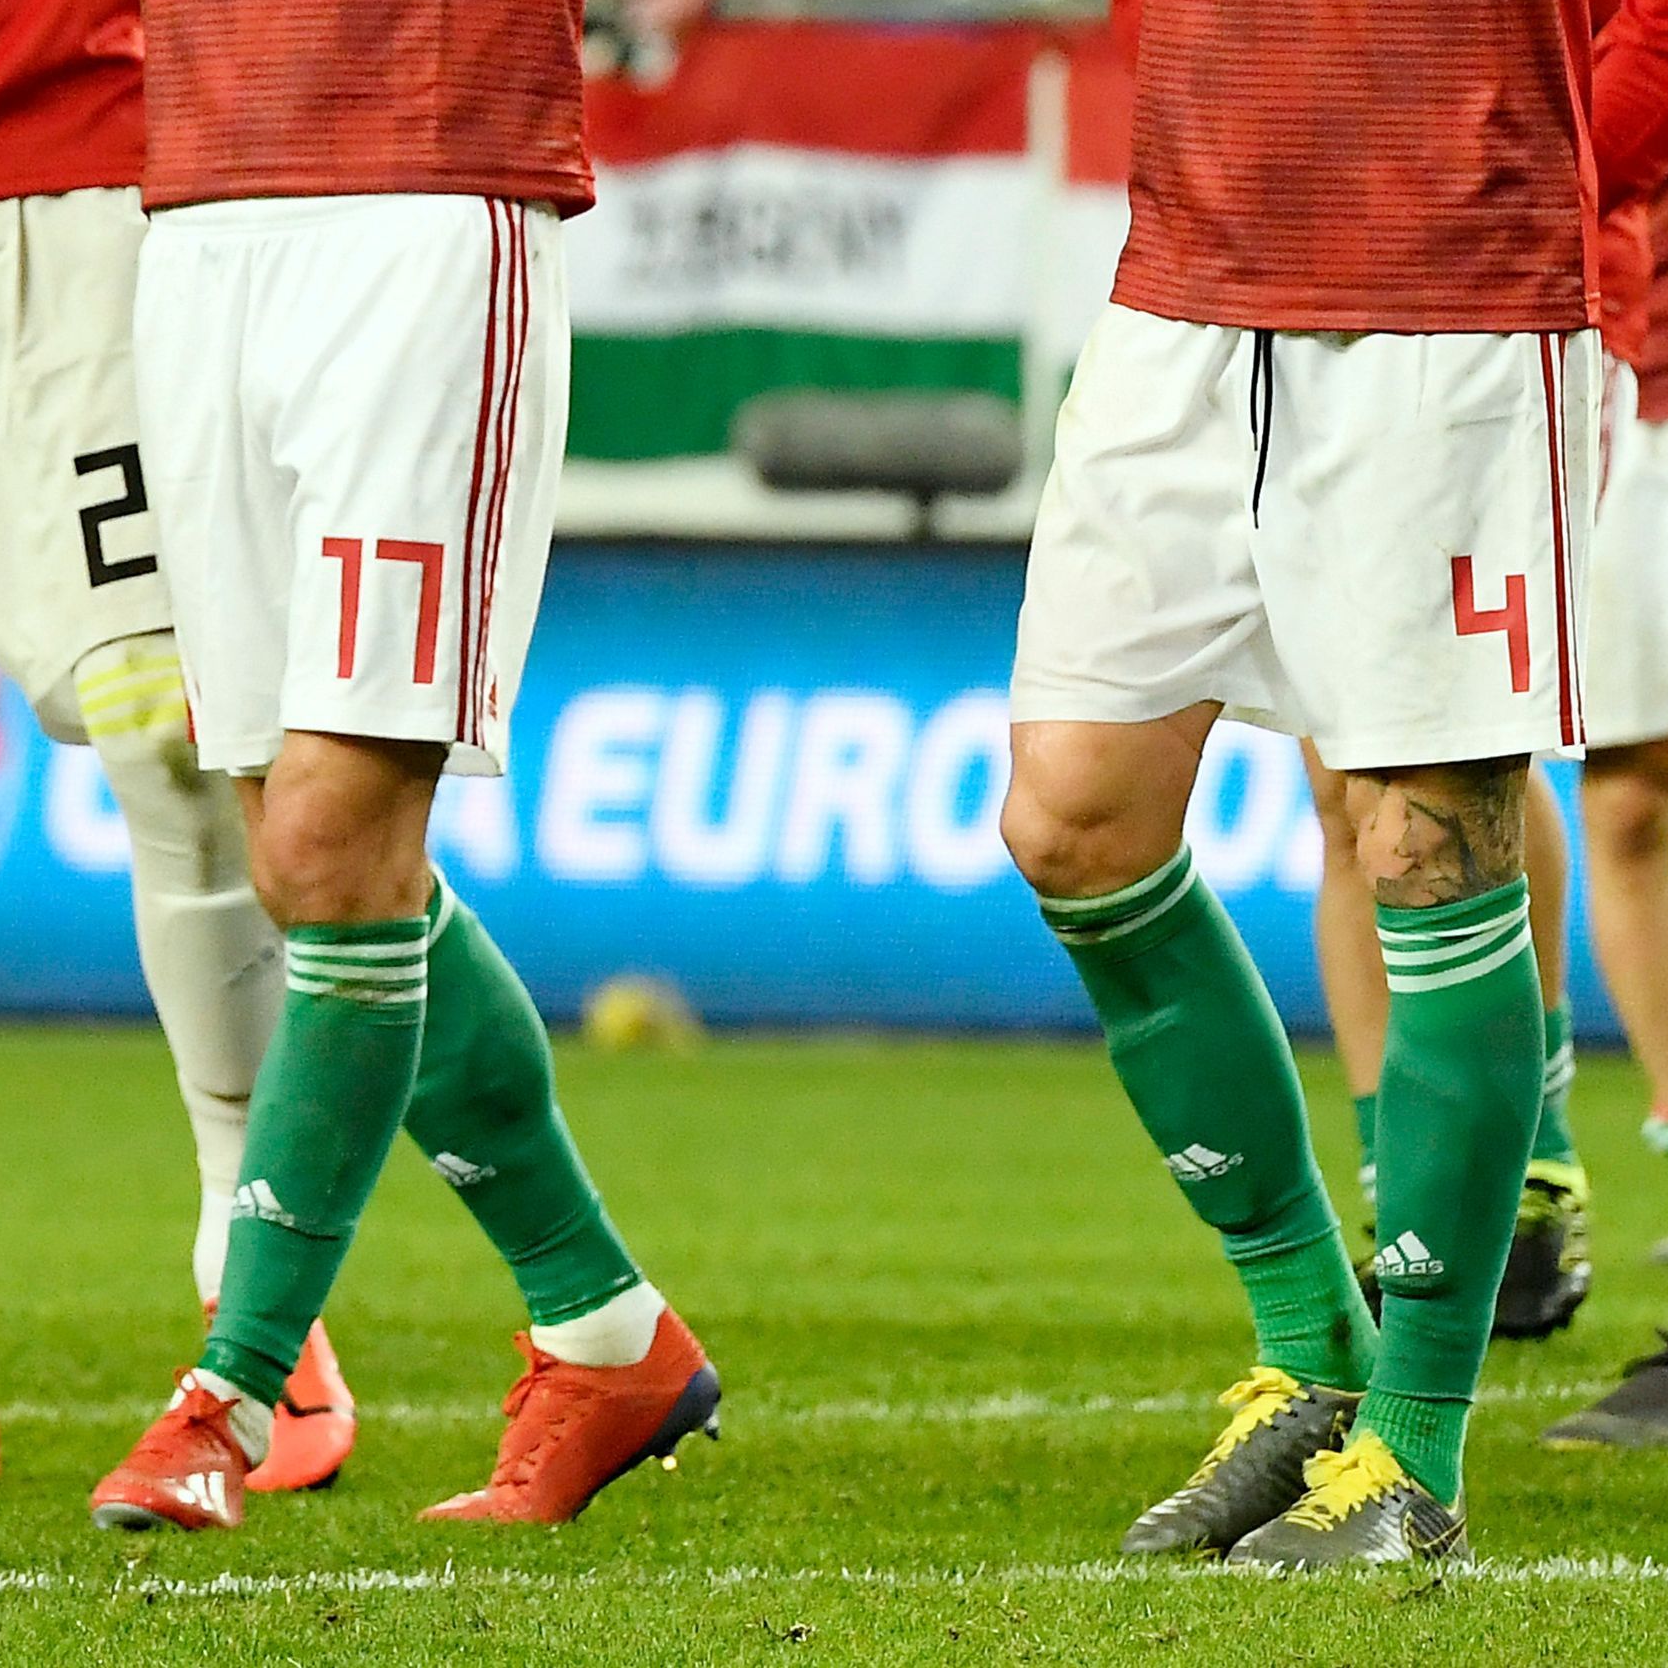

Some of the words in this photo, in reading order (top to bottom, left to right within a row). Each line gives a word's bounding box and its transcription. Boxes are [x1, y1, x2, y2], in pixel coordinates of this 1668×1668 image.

[321, 536, 445, 685] 17
[1451, 555, 1531, 693] 4
[535, 687, 1022, 888] EURO
